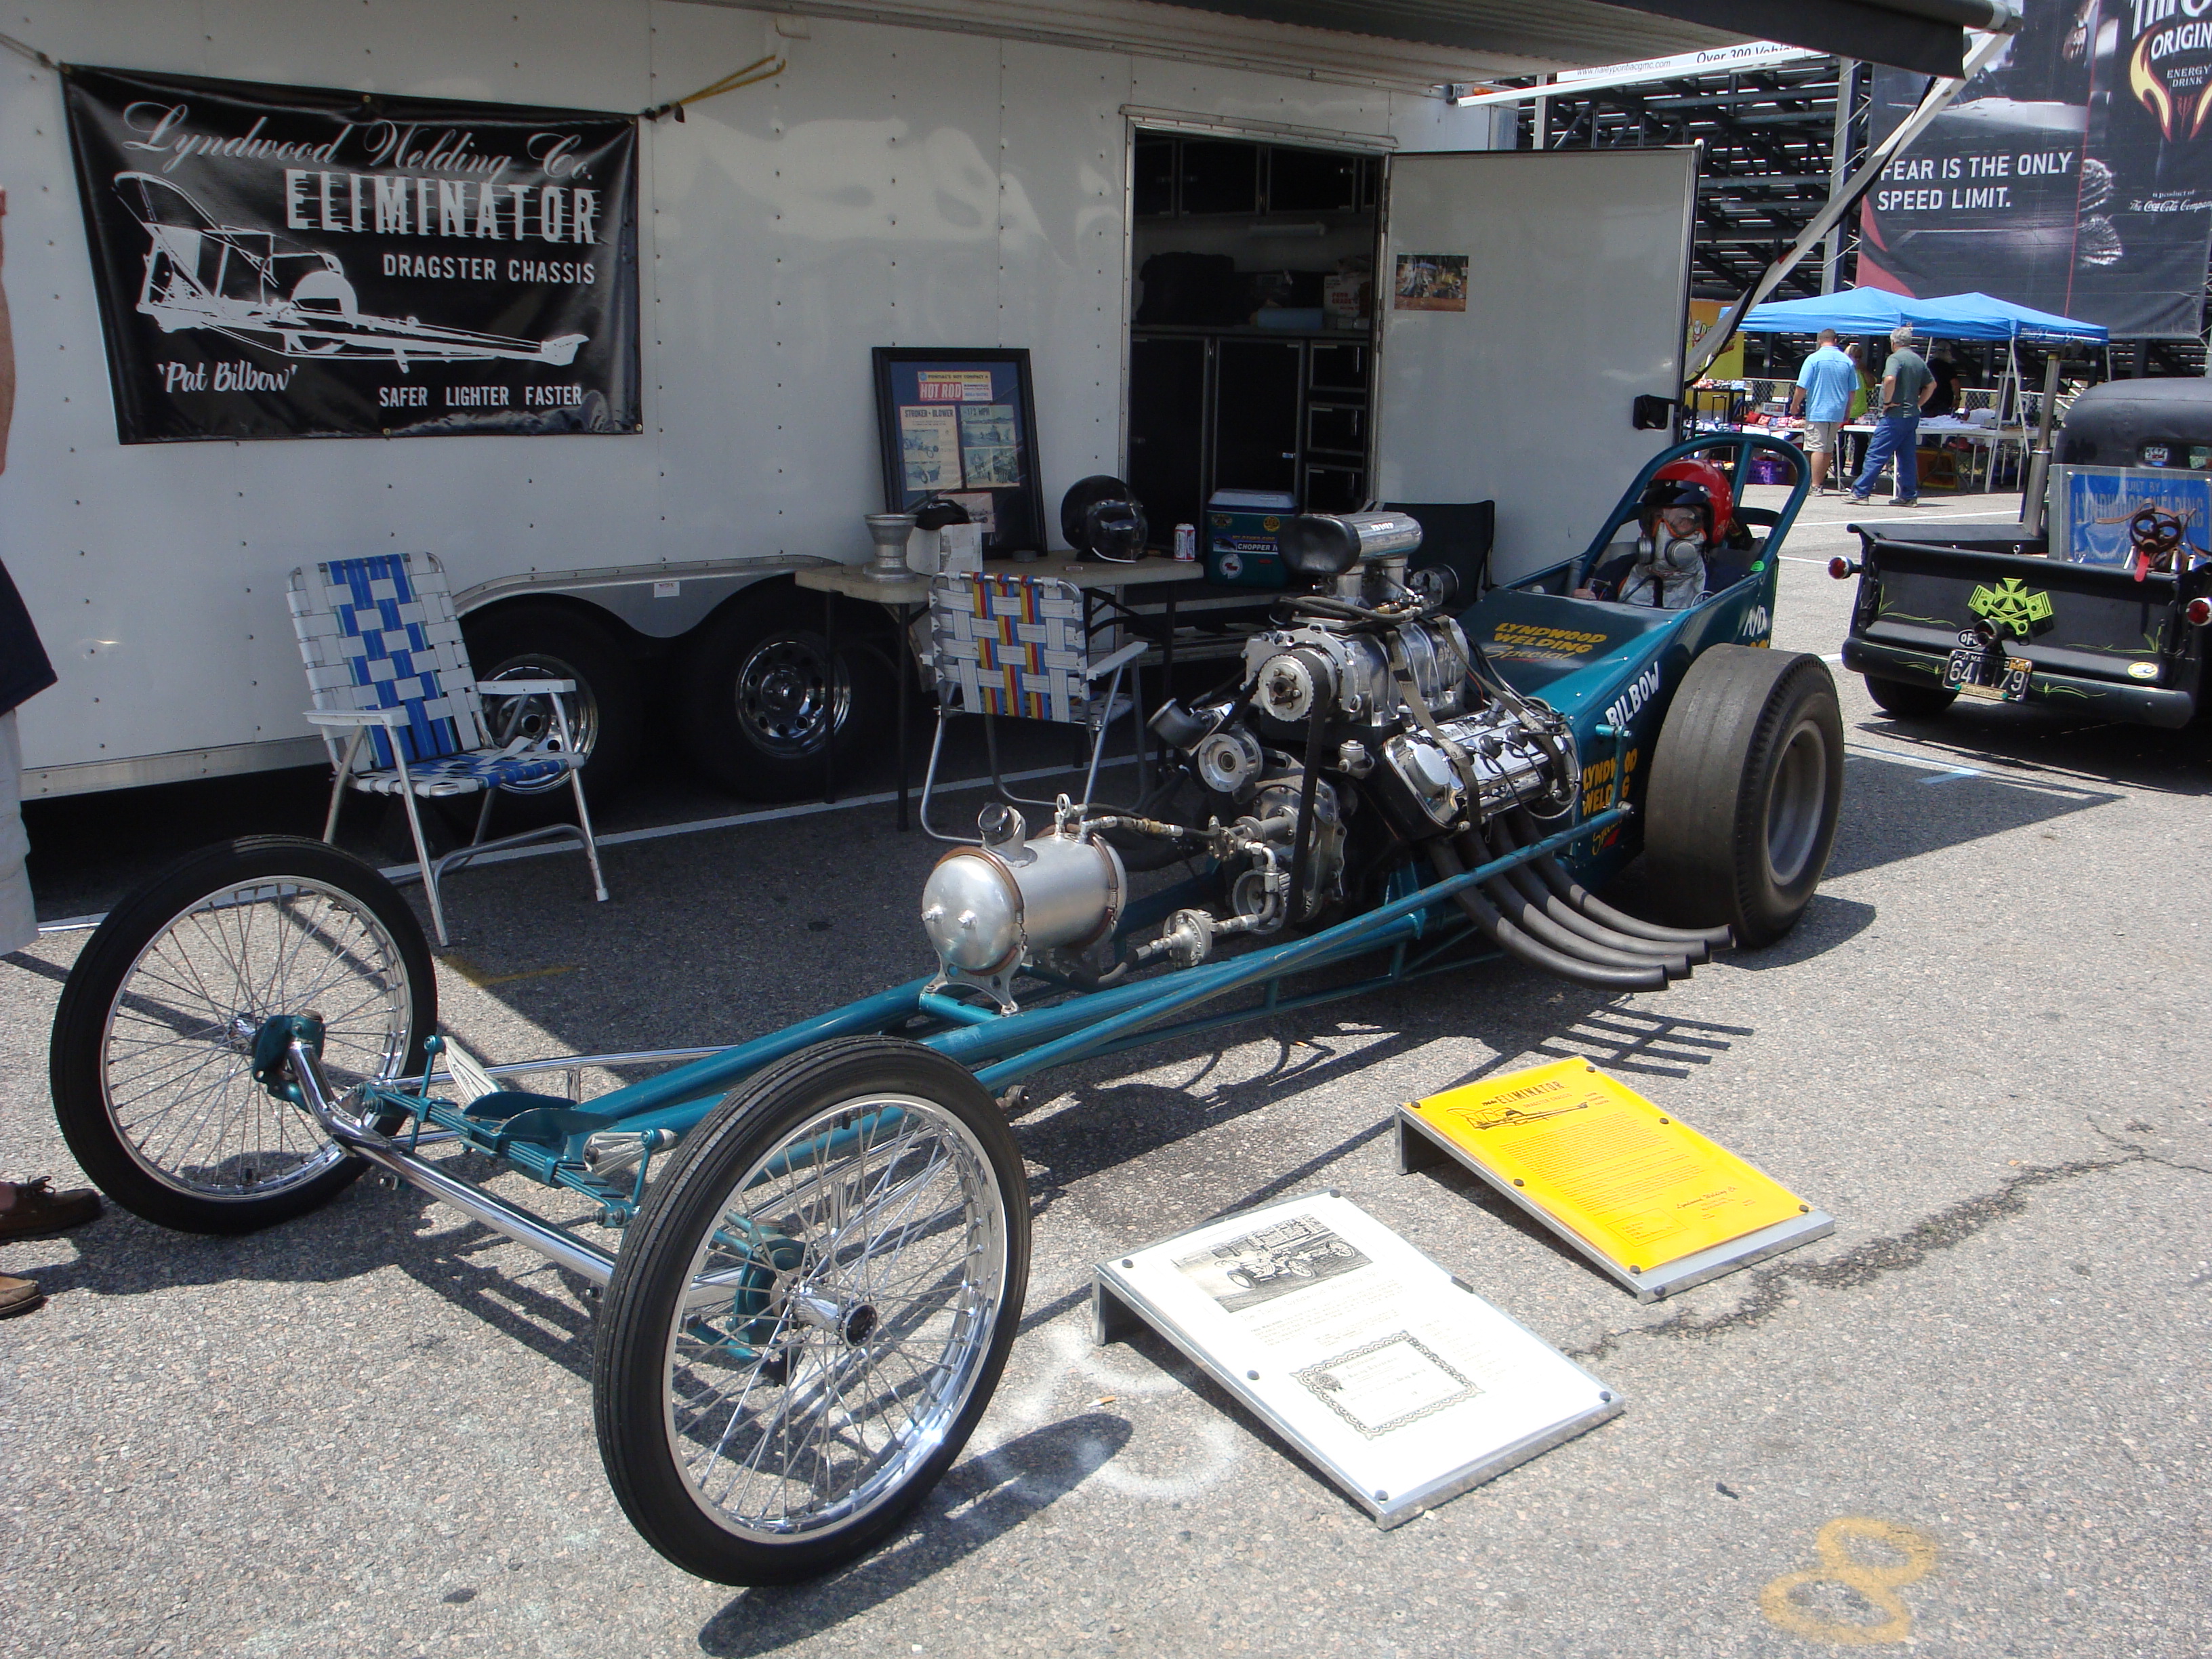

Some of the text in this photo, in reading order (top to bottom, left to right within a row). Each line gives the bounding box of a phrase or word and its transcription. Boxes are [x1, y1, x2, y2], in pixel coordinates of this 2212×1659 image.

[1696, 52, 1727, 65] Over
[1729, 47, 1751, 60] 300
[2167, 64, 2209, 79] ENERGY
[2172, 76, 2203, 88] DRINK
[123, 100, 594, 182] Lyndwood Welding Co.
[1881, 151, 2073, 182] FEAR IS THE ONLY
[285, 168, 600, 245] ELIMINATOR
[1877, 186, 2011, 212] SPEED LIMIT.
[2129, 199, 2143, 212] The
[384, 253, 596, 285] DRAGSTER CHASSIS
[379, 386, 583, 408] SAFER LIGHTER FASTER
[920, 383, 962, 398] HOT ROD
[2120, 480, 2161, 493] UILT BY
[1492, 632, 1593, 654] WELDING
[1495, 621, 1607, 644] LYNDWOOD
[1482, 644, 1578, 661] Special
[1605, 661, 1661, 727] BILBOW
[1582, 775, 1631, 817] WELDG
[1495, 1081, 1565, 1104] ELIMINATOR
